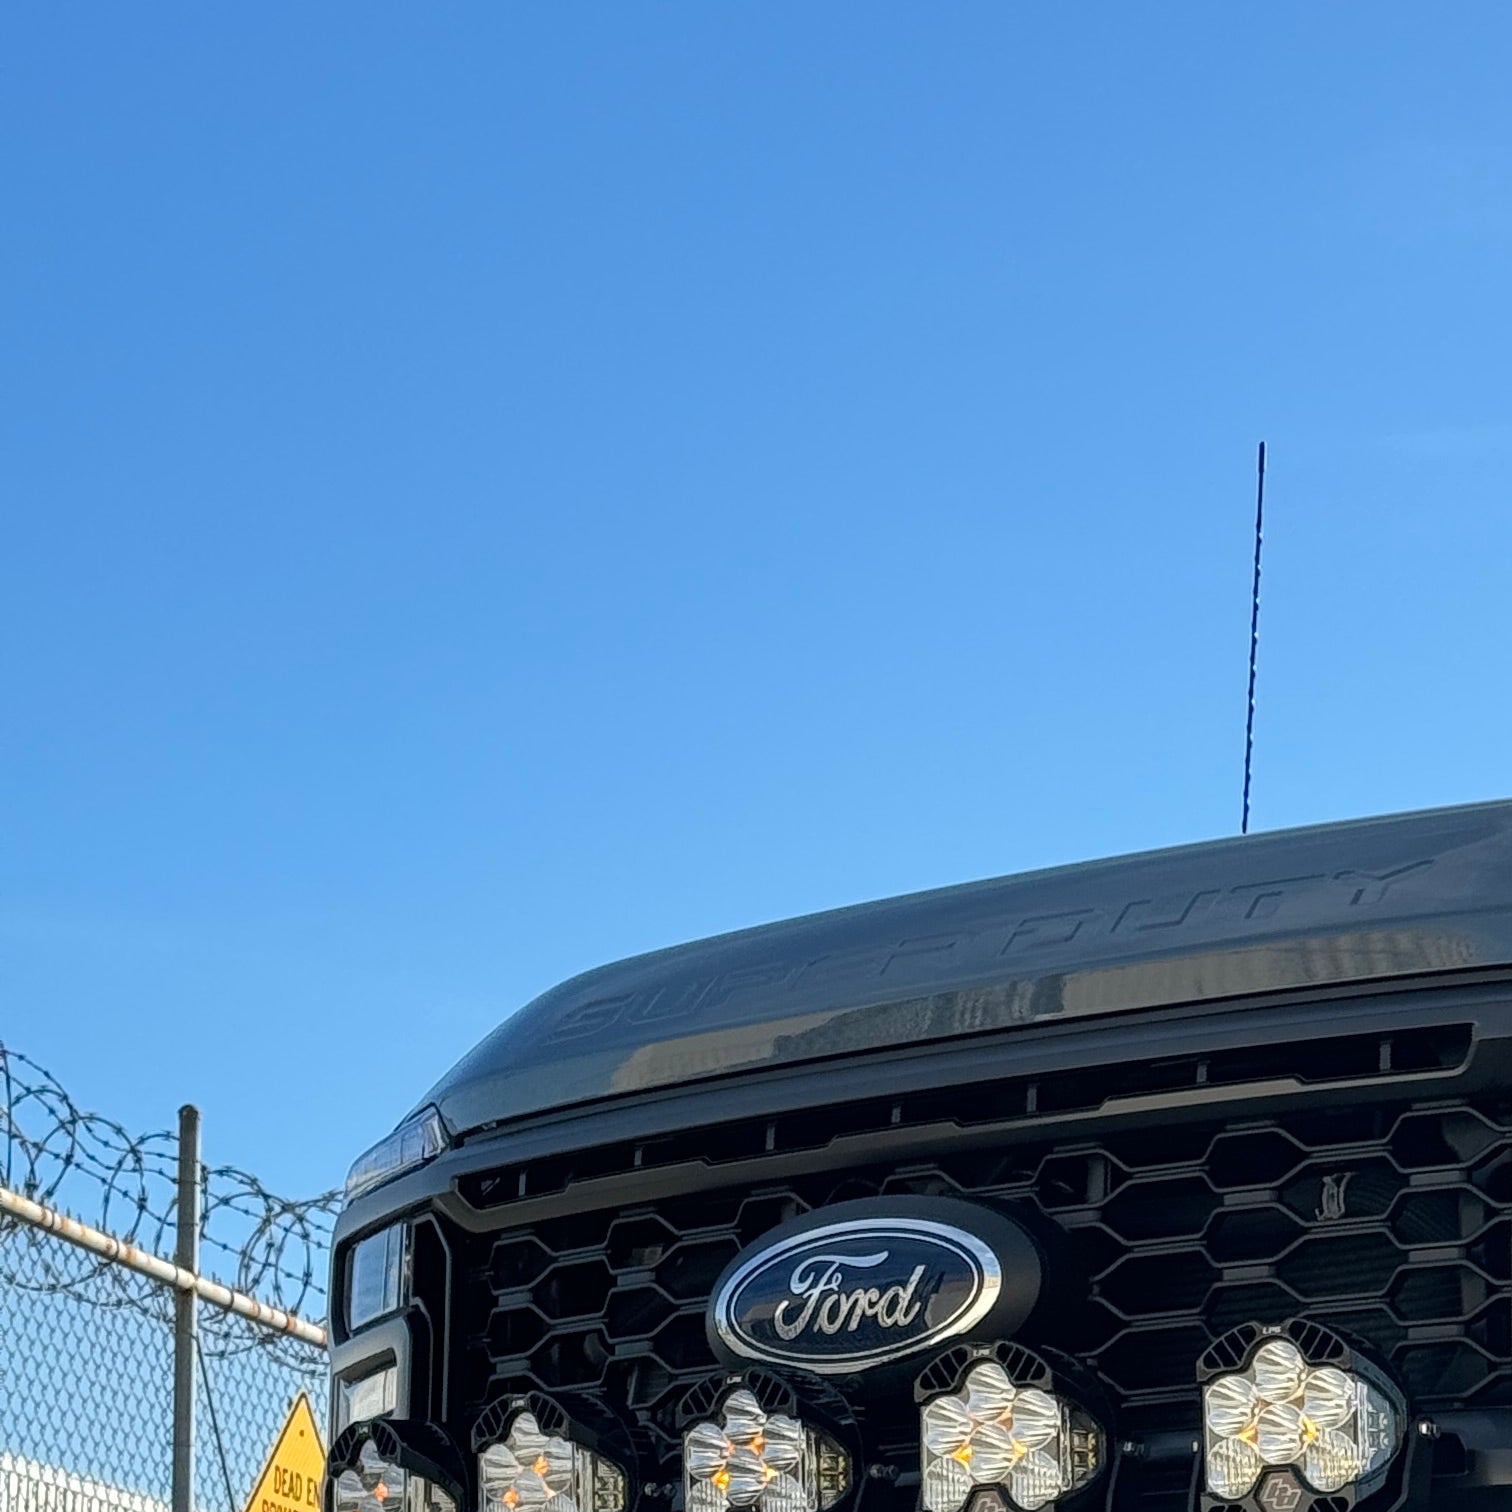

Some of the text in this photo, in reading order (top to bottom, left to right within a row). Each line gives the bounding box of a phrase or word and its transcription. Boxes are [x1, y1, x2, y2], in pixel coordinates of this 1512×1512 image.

[1000, 858, 1436, 956] DUTY
[773, 1250, 927, 1341] Ford
[274, 1465, 321, 1508] DEAD EN
